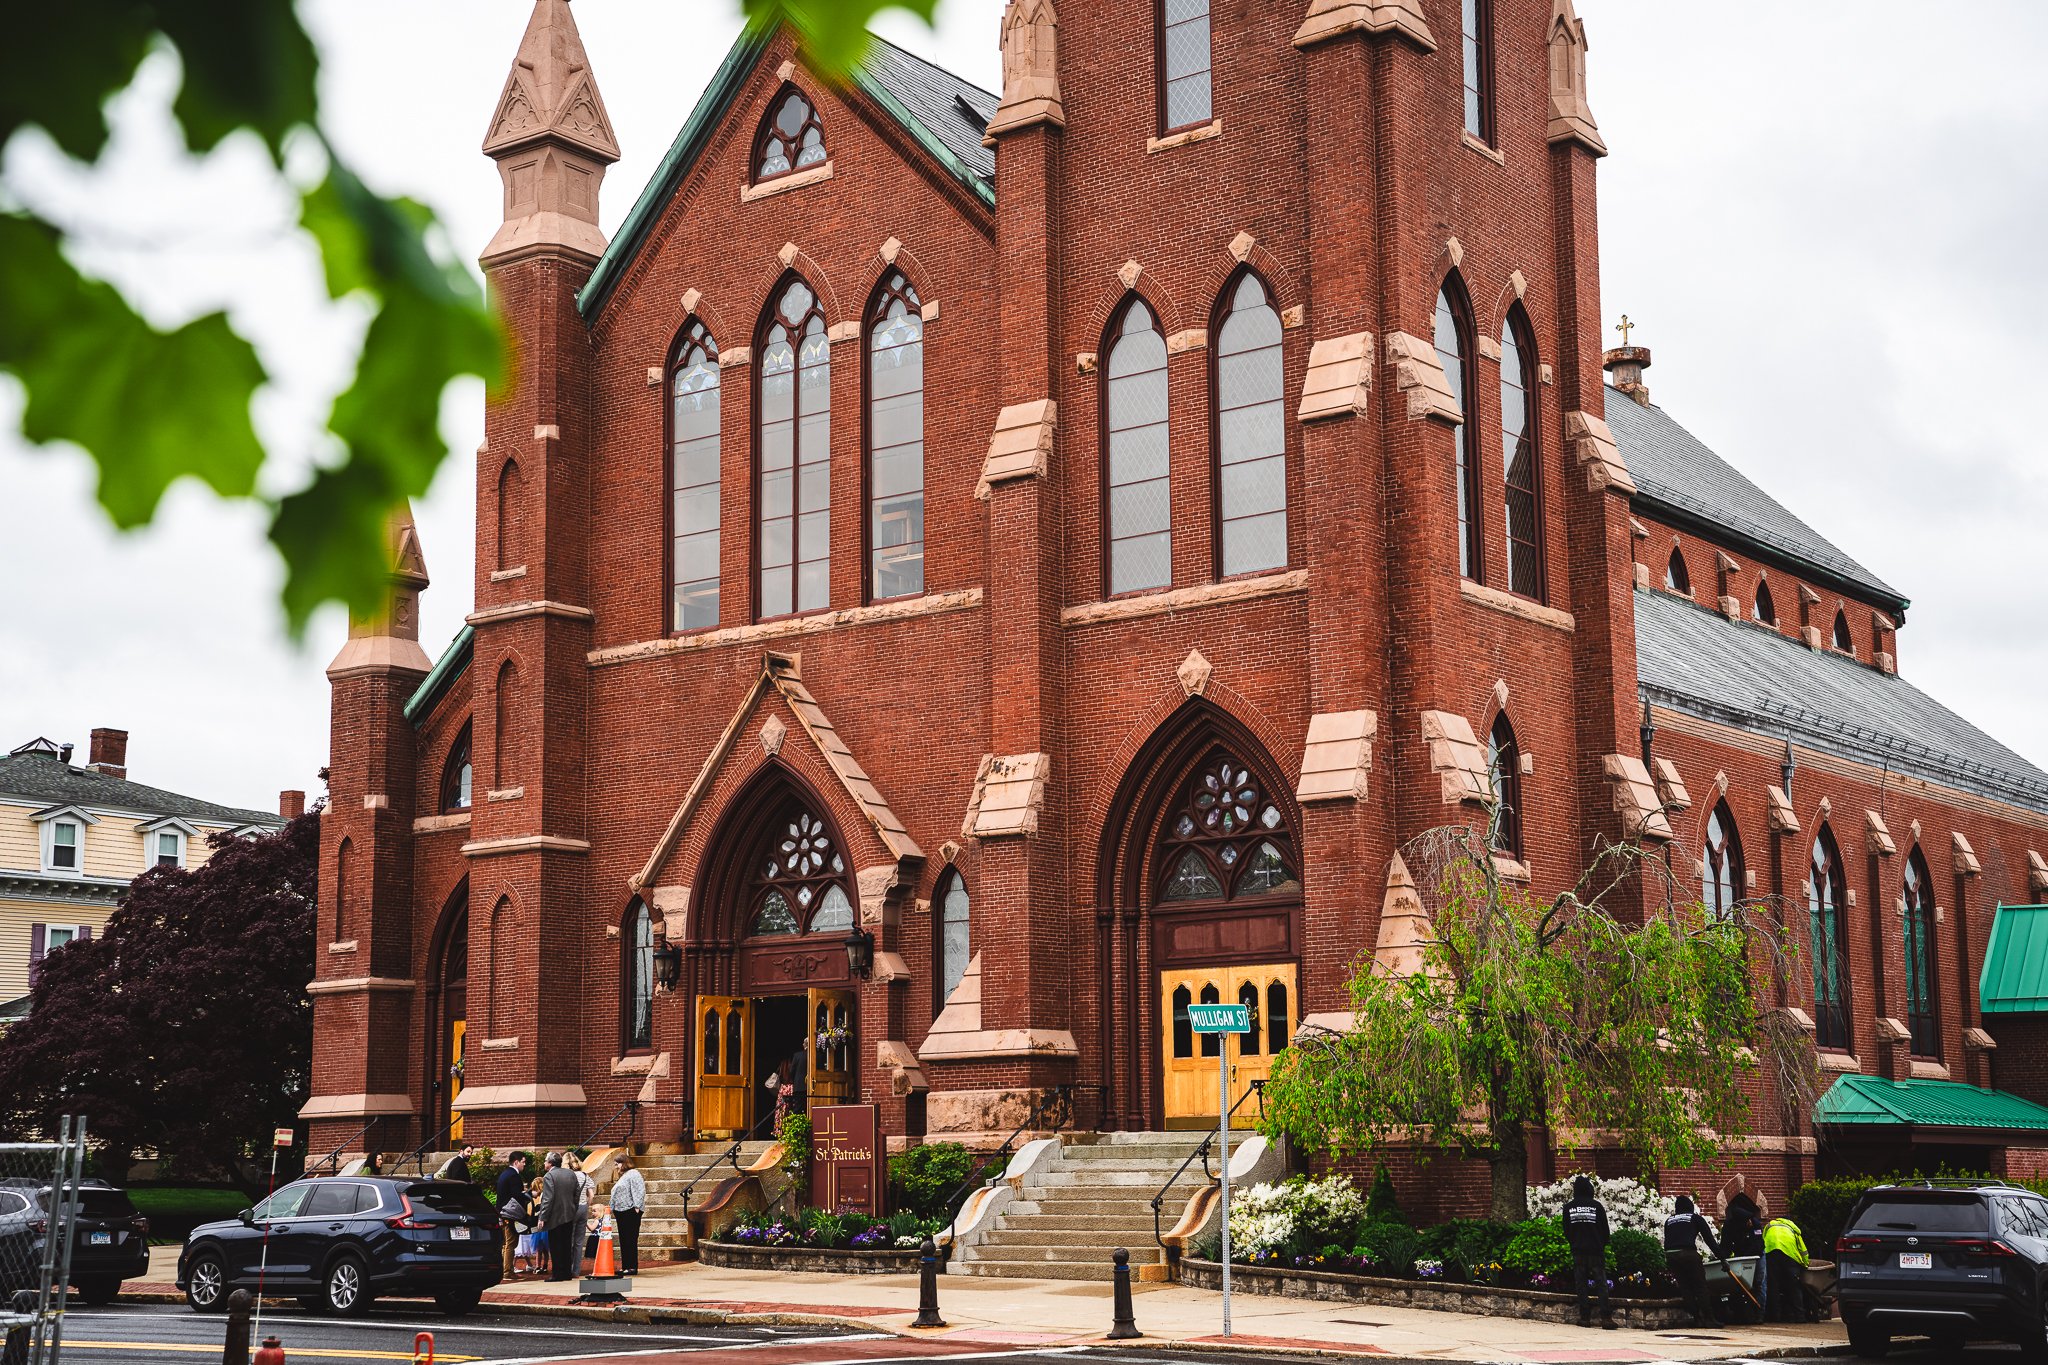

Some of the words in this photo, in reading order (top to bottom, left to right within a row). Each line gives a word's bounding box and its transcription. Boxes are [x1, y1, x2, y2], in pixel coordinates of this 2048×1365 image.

[1191, 1010, 1235, 1026] MULLIGAN
[1236, 1010, 1247, 1026] ST
[815, 1147, 830, 1161] St.
[830, 1146, 872, 1161] Patrick's
